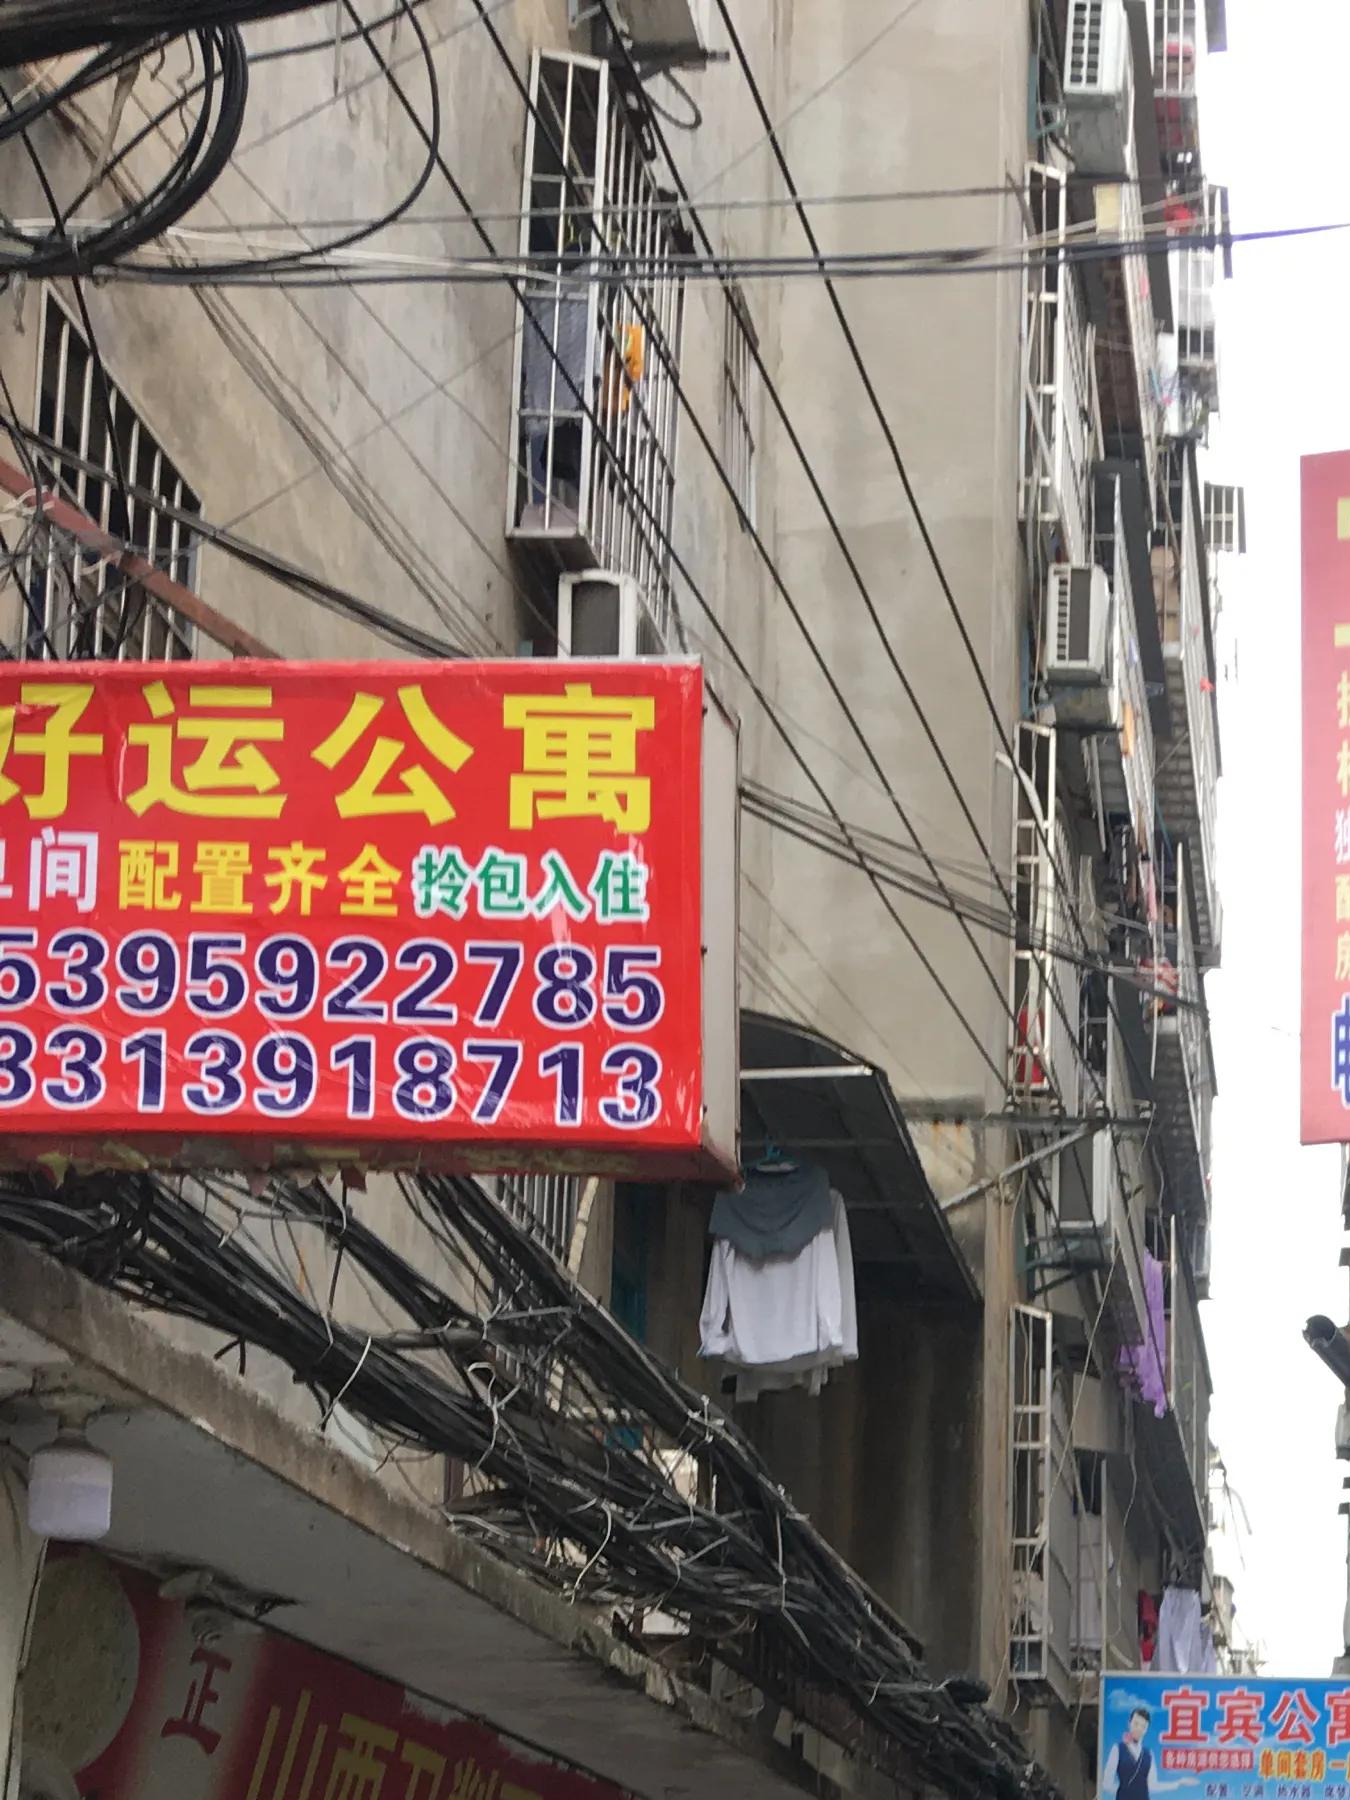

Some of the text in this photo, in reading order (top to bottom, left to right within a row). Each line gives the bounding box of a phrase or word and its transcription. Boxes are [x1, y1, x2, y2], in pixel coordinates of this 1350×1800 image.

[0, 681, 656, 833] 好运公寓
[0, 827, 648, 922] 间 配置齐全 拎包入住
[1259, 1748, 1326, 1781] 单间套房
